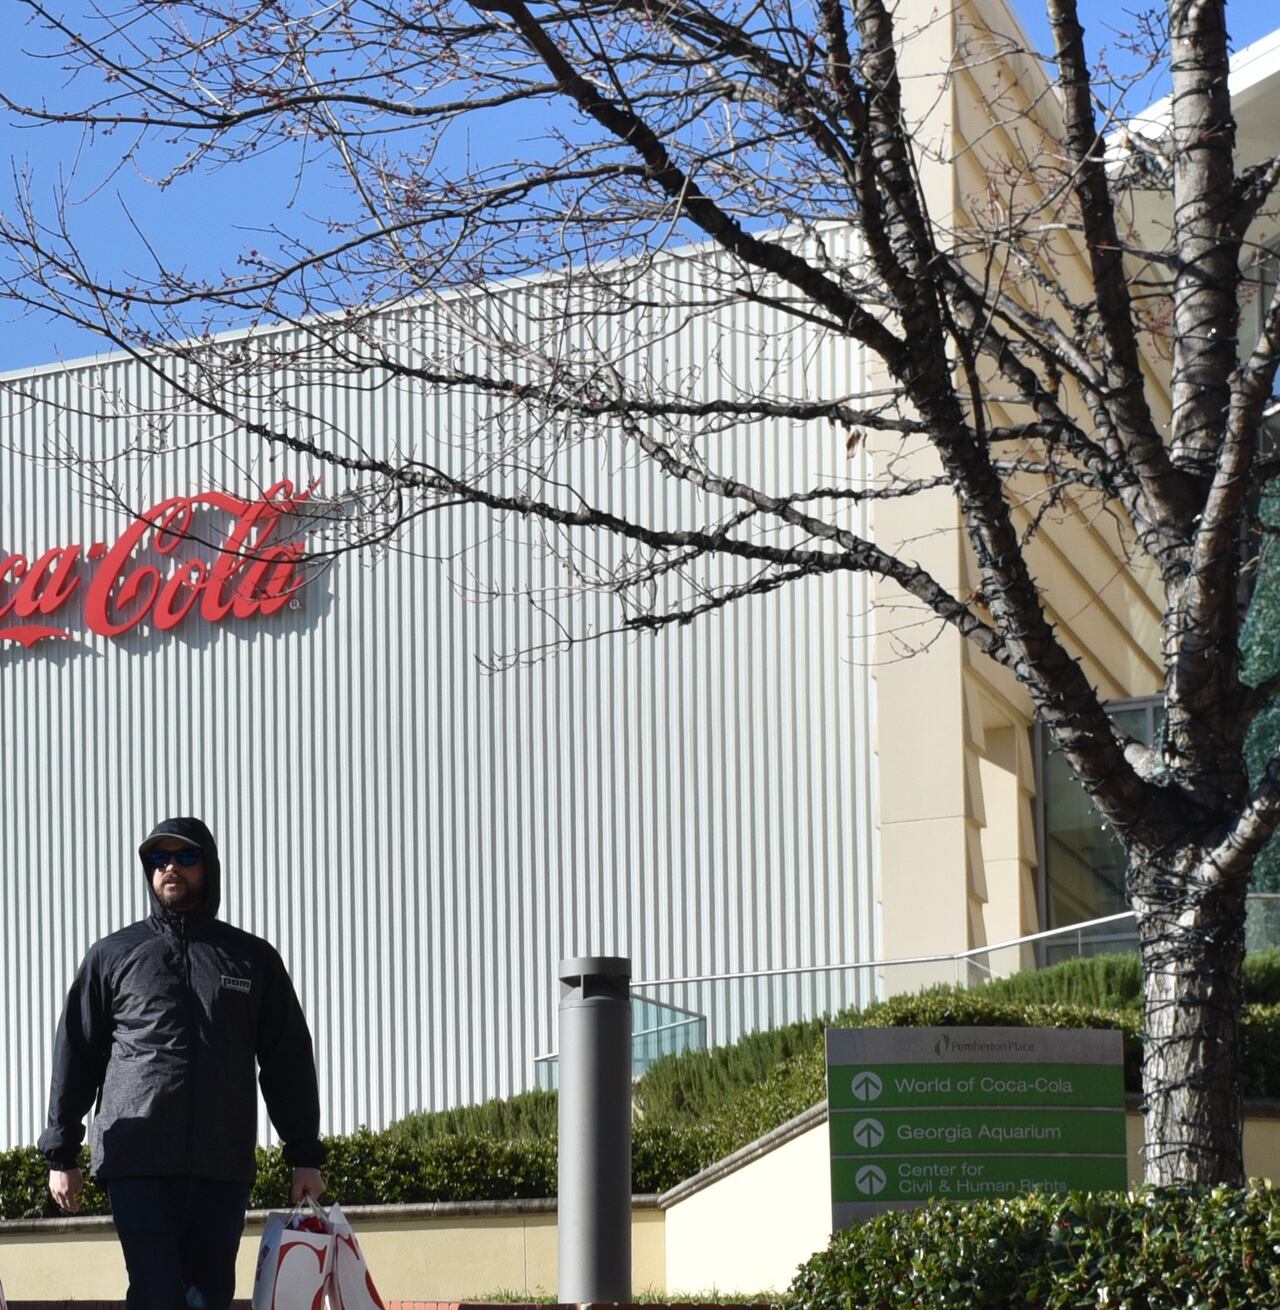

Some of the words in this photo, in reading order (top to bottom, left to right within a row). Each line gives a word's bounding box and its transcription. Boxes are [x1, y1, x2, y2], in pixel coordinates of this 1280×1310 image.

[951, 1040, 1007, 1052] Pemberton
[1008, 1041, 1035, 1052] Place
[894, 1077, 951, 1093] World
[957, 1077, 975, 1093] of
[980, 1077, 1073, 1094] Coca-Cola
[897, 1124, 972, 1142] Georgia
[979, 1124, 1062, 1142] Aquarium
[898, 1163, 956, 1177] Center
[961, 1162, 984, 1176] for
[899, 1179, 933, 1193] Civil
[940, 1180, 951, 1193] &
[956, 1180, 1015, 1193] Human
